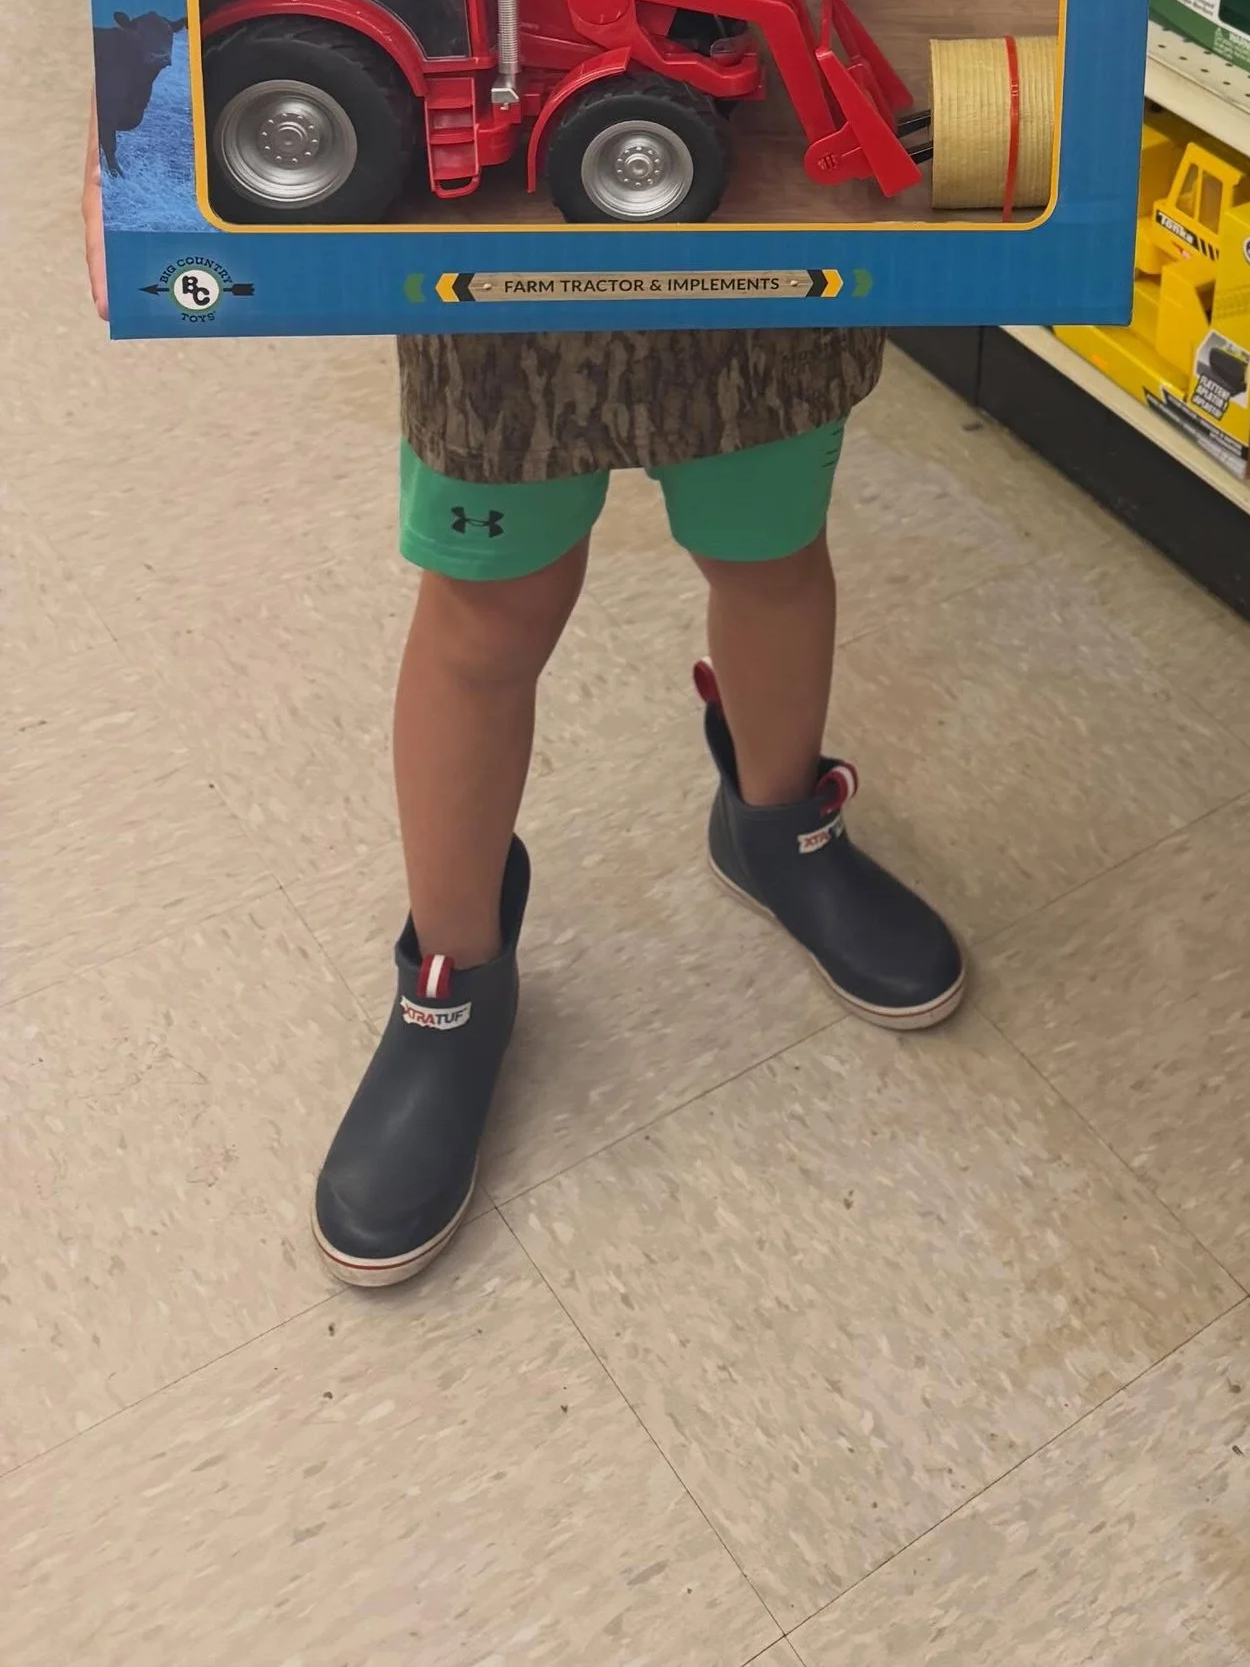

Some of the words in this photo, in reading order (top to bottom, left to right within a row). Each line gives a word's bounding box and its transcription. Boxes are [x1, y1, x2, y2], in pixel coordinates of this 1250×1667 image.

[1159, 213, 1195, 245] Tonka
[160, 268, 175, 285] BIG
[176, 257, 233, 284] COUNTRY
[182, 276, 210, 305] BC
[504, 277, 555, 294] FARM
[561, 276, 650, 294] TRACTOR
[650, 276, 662, 292] &
[667, 275, 779, 293] IMPLEMENTS
[181, 312, 213, 323] TOYS
[404, 1006, 466, 1026] XTRATUF
